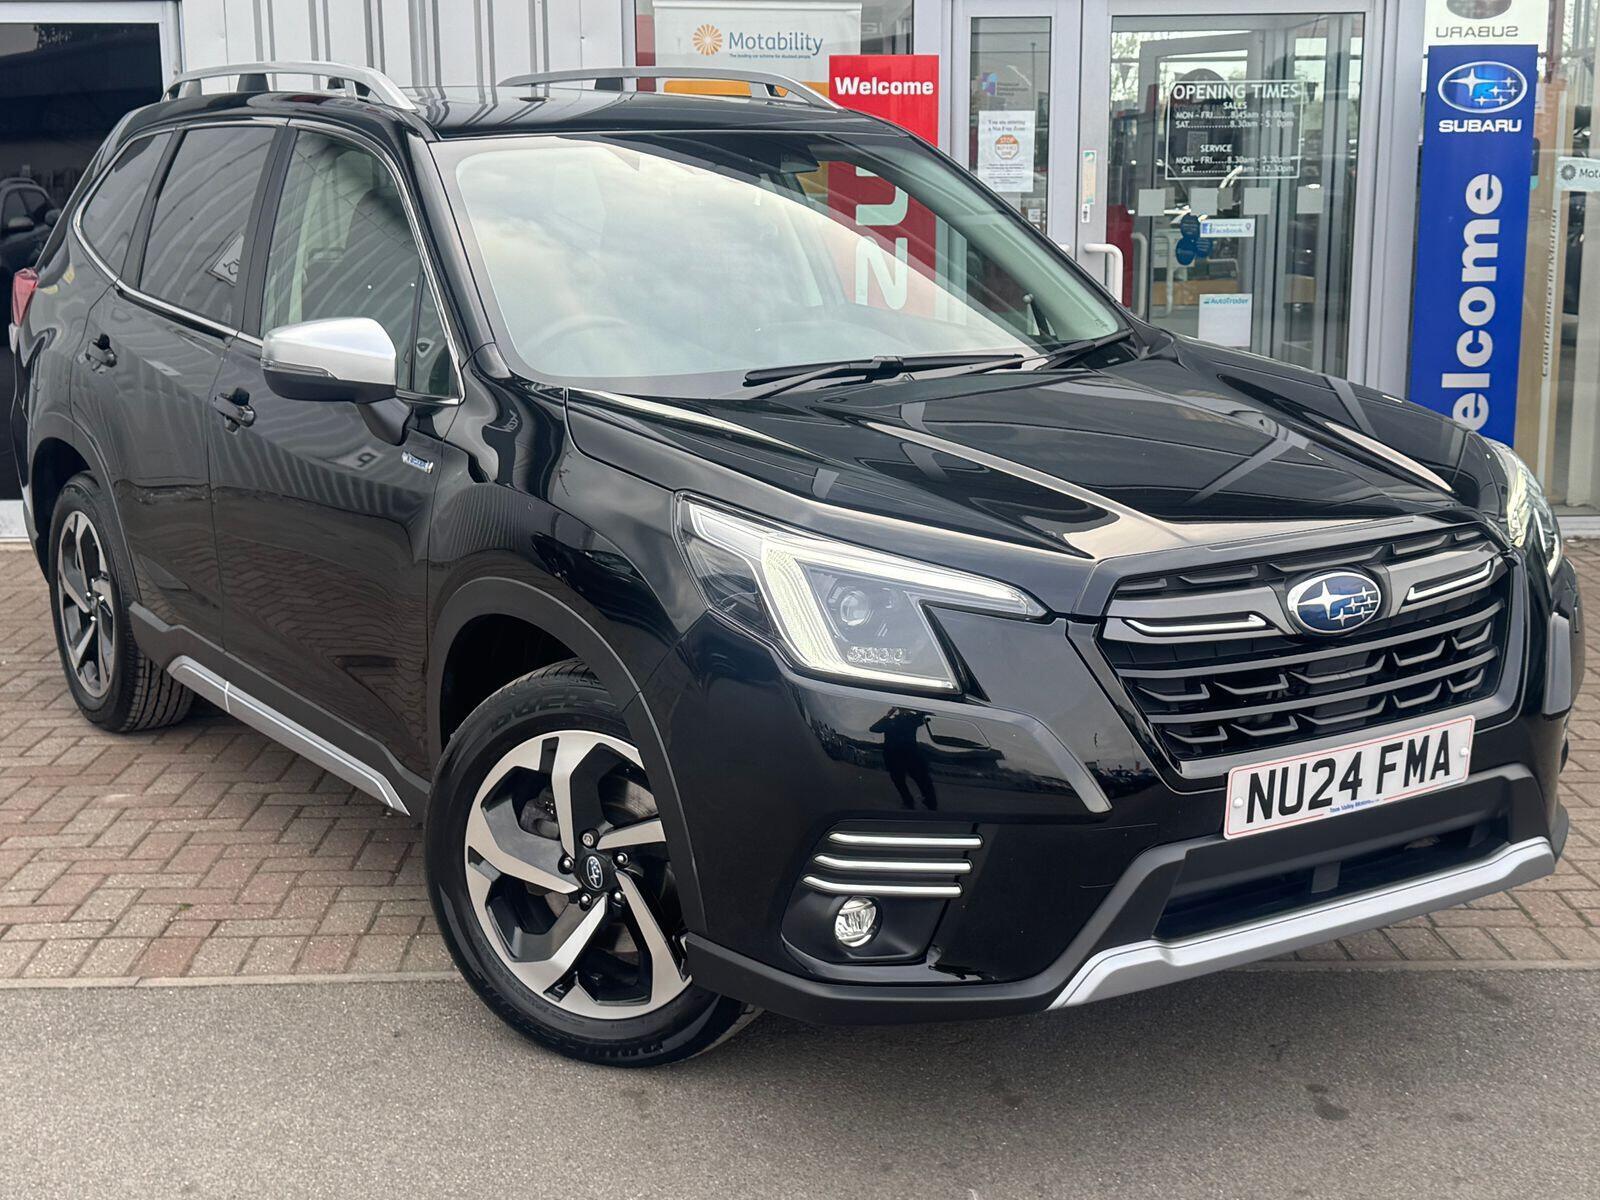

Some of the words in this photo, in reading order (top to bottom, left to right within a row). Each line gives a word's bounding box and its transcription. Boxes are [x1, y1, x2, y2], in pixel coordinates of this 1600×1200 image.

[729, 32, 824, 56] Motability
[834, 77, 934, 96] Welcome
[1173, 84, 1246, 100] OPENING
[1251, 83, 1299, 99] TIMES
[1223, 101, 1247, 110] SALES
[1175, 111, 1194, 119] MON
[1438, 119, 1523, 133] SUBARU
[1200, 144, 1232, 153] SERVICE
[1175, 156, 1194, 164] MON
[1579, 168, 1600, 179] Mot
[1441, 173, 1503, 432] elcome
[1246, 751, 1363, 824] NU24
[1375, 730, 1451, 795] FMA
